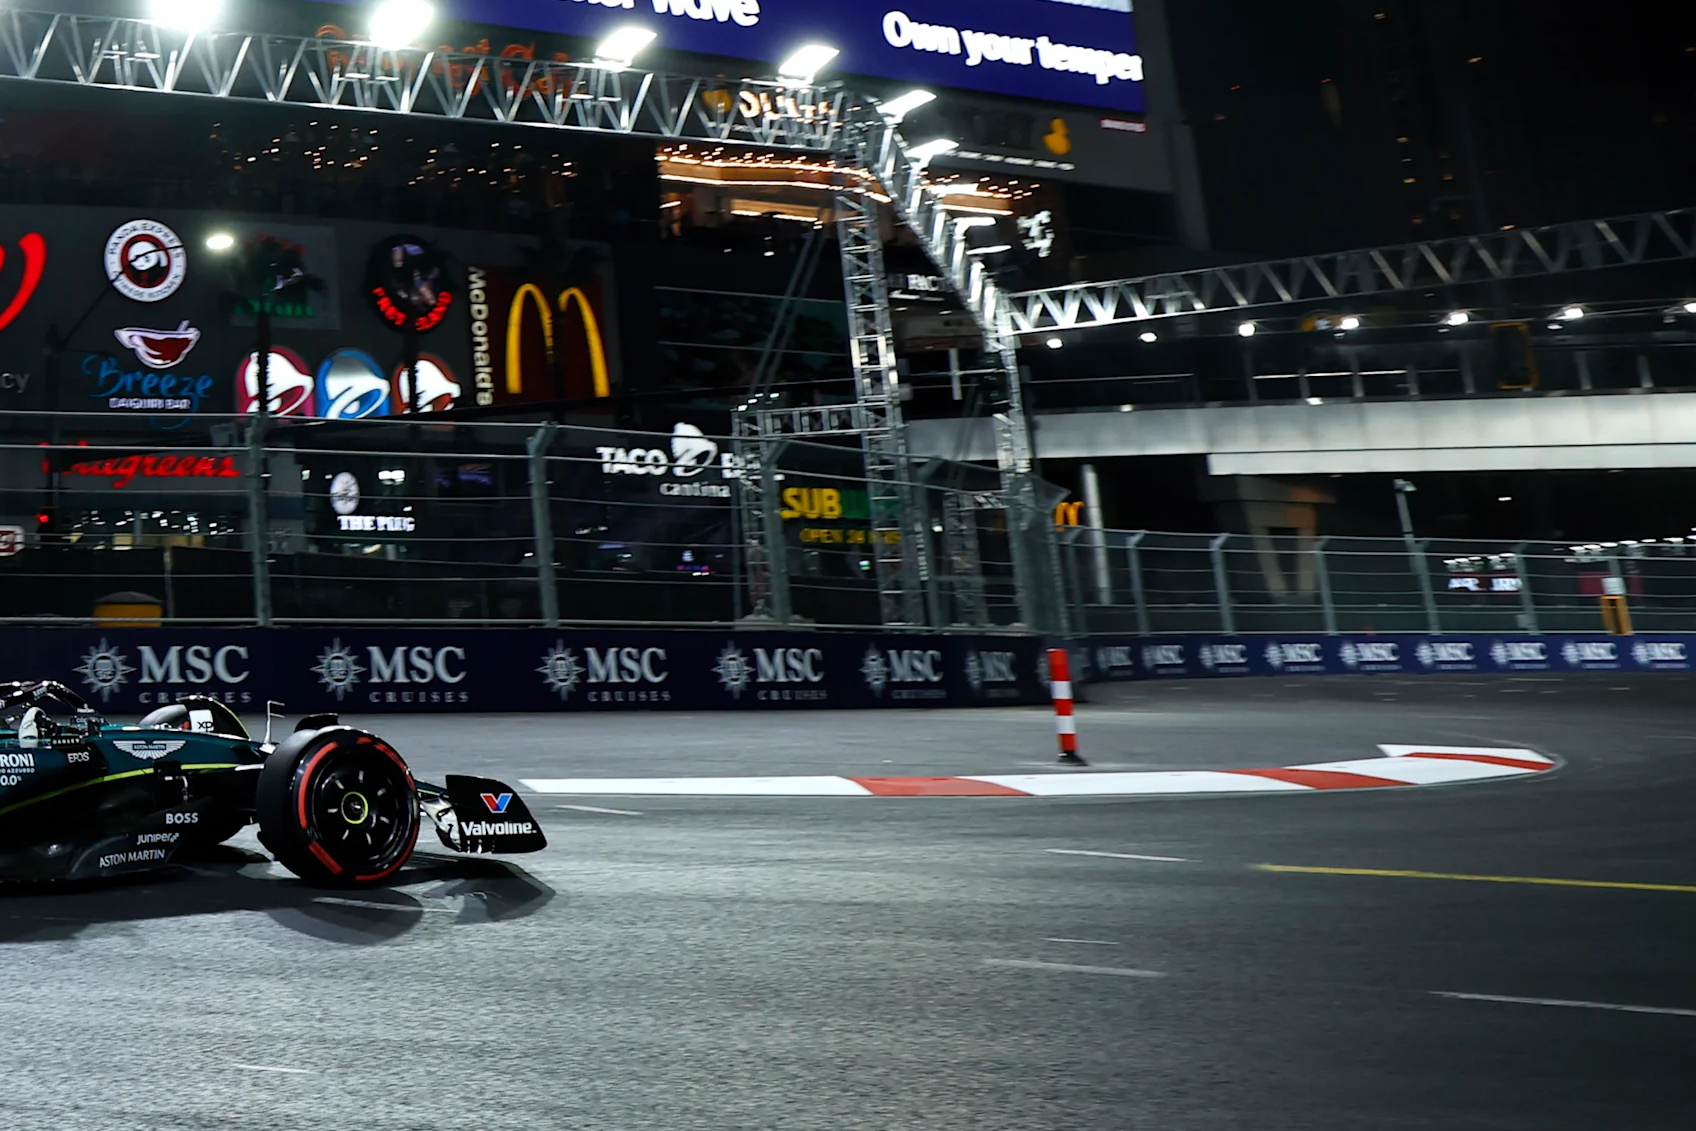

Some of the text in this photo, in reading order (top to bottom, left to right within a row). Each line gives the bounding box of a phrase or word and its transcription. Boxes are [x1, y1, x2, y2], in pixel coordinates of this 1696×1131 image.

[883, 11, 961, 55] Own
[960, 30, 1035, 66] your
[467, 266, 495, 406] McDonald's
[596, 446, 669, 475] TACO
[659, 482, 732, 498] cantina
[336, 515, 377, 531] THE
[137, 645, 250, 684] MSC
[366, 646, 467, 684] MSC
[583, 647, 669, 683] MSC
[753, 647, 825, 683] MSC
[887, 649, 944, 682] MSC
[368, 691, 469, 703] CRUISES
[587, 690, 672, 702] CRUISES
[67, 751, 90, 763] EPOS
[165, 812, 199, 825] BOSS
[460, 821, 534, 837] Valvoline
[99, 848, 166, 869] ASTON MARTIN
